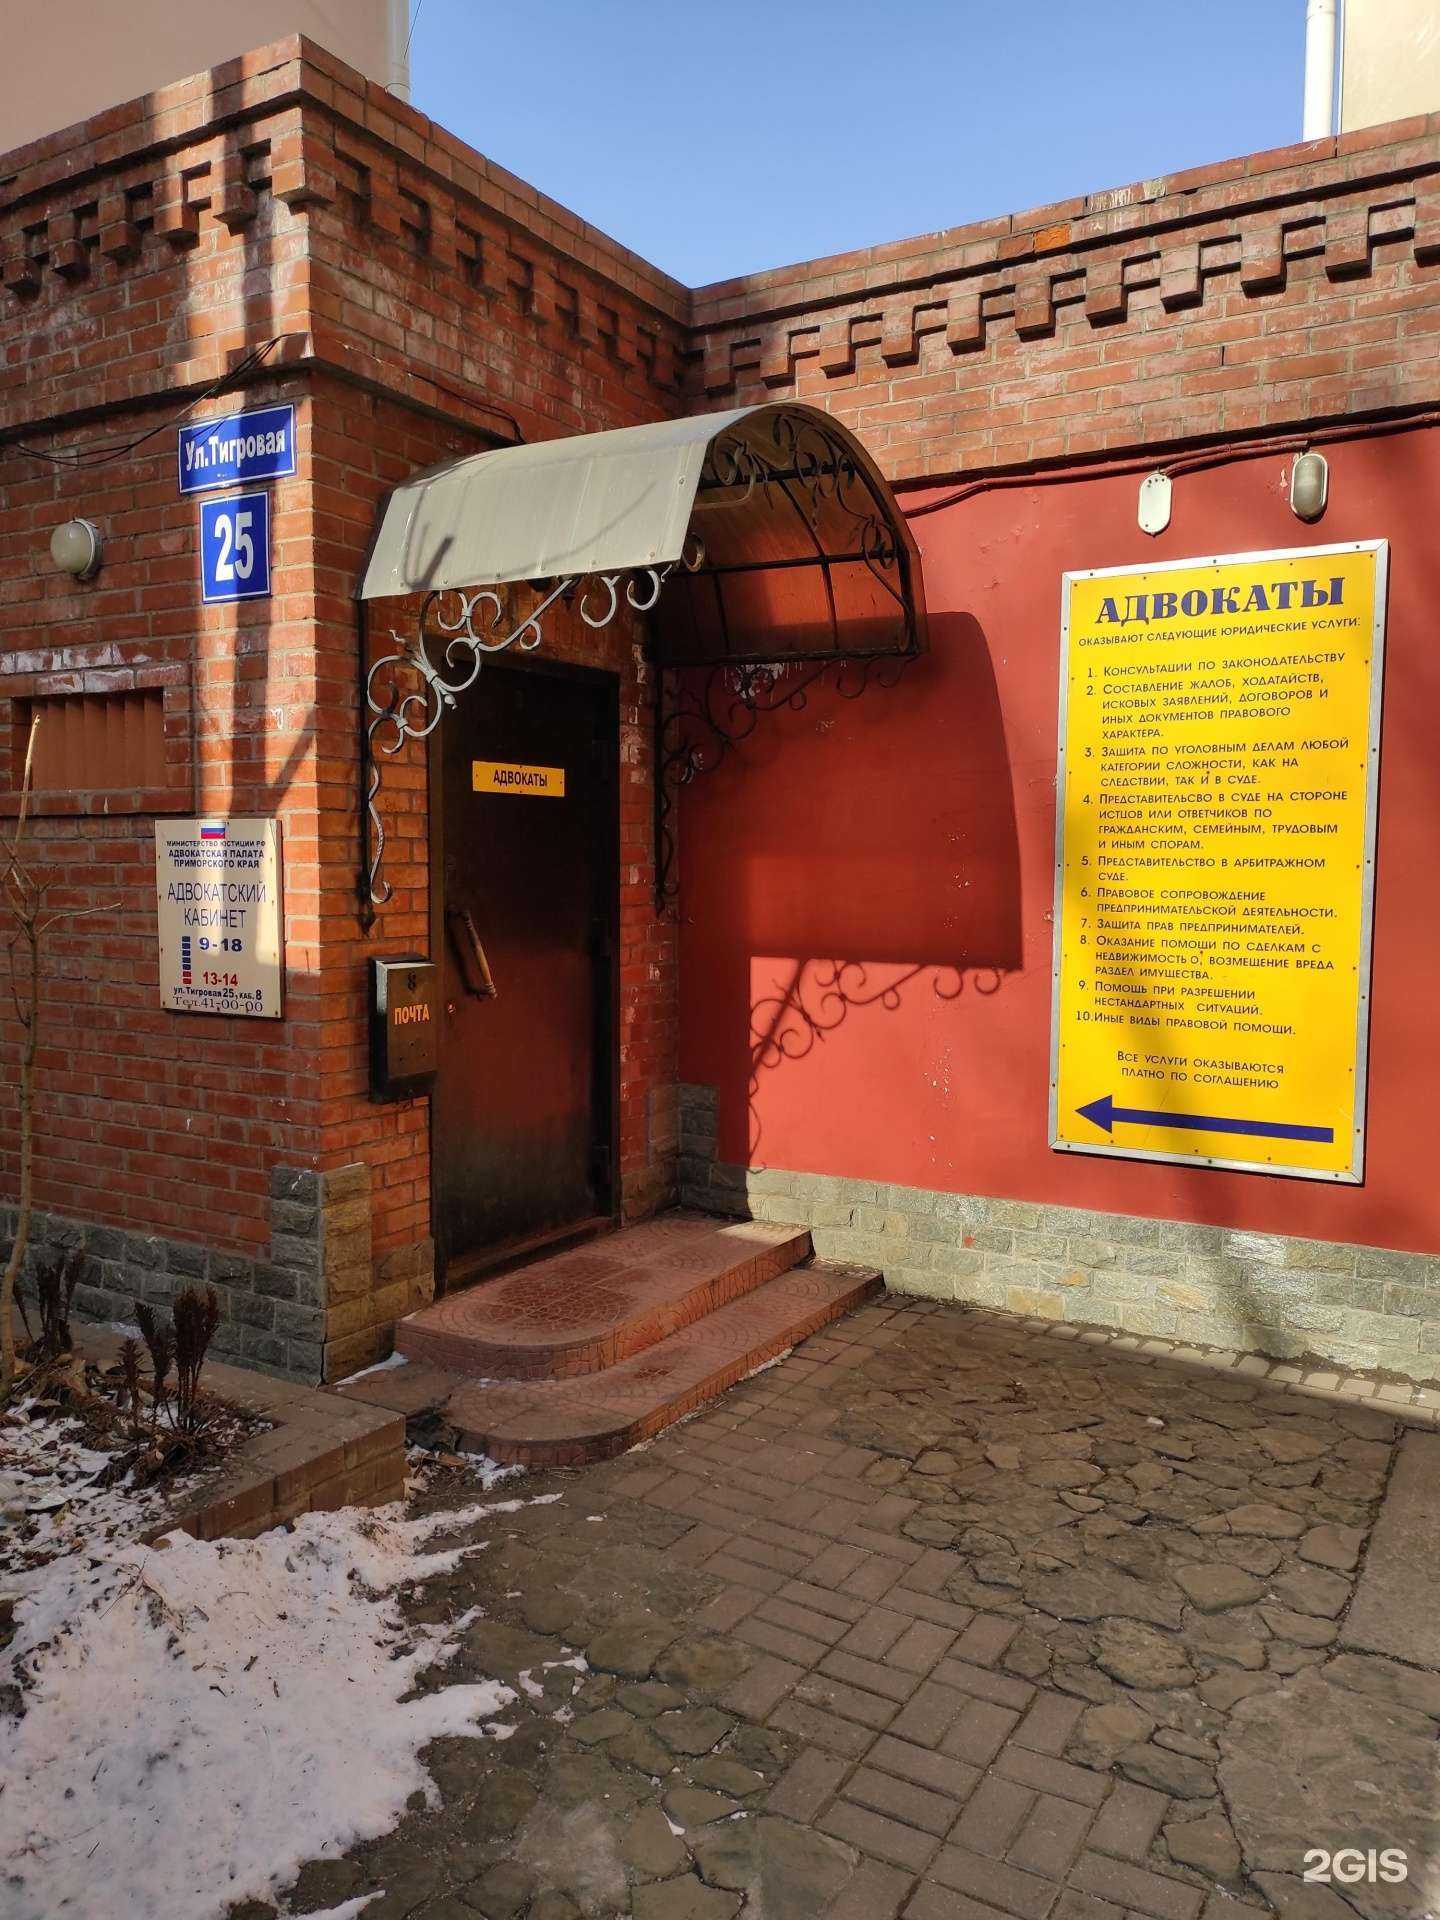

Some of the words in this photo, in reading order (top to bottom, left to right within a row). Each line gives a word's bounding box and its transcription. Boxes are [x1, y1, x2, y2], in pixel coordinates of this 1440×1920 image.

[186, 429, 285, 472] Ул.Тигровая
[214, 512, 253, 581] 25
[1095, 577, 1345, 626] АДВОКАТЫ
[1079, 634, 1144, 647] ОКАЗЫВАЮТ
[1147, 628, 1217, 642] СЛЕДУЮЩИЕ
[1221, 622, 1307, 636] ЮРИДИЧЕСКИЕ
[1312, 617, 1361, 629] УСЛУГИ:
[1198, 661, 1216, 670] ПО
[1222, 653, 1345, 669] ЗАКОНОДАТЕЛЬСТВУ
[1190, 679, 1235, 690] ЖАЛОБ,
[1243, 673, 1324, 686] ХОДАТАЙСТВ,
[1102, 697, 1156, 709] ИСКОВЫХ
[1163, 694, 1232, 706] ЗАЯВЛЕНИЙ,
[1239, 690, 1313, 703] ДОГОВОРОВ
[1320, 689, 1328, 699] И
[1102, 714, 1133, 724] ИНЫХ
[1139, 710, 1214, 723] ДОКУМЕНТОВ
[1220, 706, 1291, 719] ПРАВОВОГО
[1102, 729, 1163, 739] ХАРАКТЕРА.
[1152, 746, 1168, 755] ПО
[1175, 742, 1246, 754] УГОЛОВНЫМ
[1253, 741, 1295, 752] ДЕЛАМ
[1300, 737, 1349, 751] ЛЮБОЙ
[1101, 760, 1160, 772] КАТЕГОРИИ
[1166, 758, 1246, 770] СЛОЖНОСТИ,
[1253, 758, 1276, 768] КАК
[1282, 757, 1298, 767] НА
[494, 770, 547, 787] АДВОКАТЫ
[1101, 776, 1168, 787] СЛЕДСТВИИ,
[1176, 775, 1195, 785] ТАК
[1201, 775, 1209, 784] И
[1215, 775, 1222, 784] В
[1228, 774, 1261, 784] СУДЕ.
[1083, 794, 1093, 805] 4.
[1219, 793, 1225, 801] В
[1232, 791, 1261, 802] СУДЕ
[1268, 791, 1284, 801] НА
[1290, 790, 1348, 801] СТОРОНЕ
[1099, 809, 1143, 819] ИСТЦОВ
[1149, 809, 1172, 818] ИЛИ
[1178, 808, 1247, 818] ОТВЕТЧИКОВ
[1255, 808, 1272, 818] ПО
[1099, 824, 1187, 836] ГРАЖДАНСКИМ,
[1194, 821, 1265, 835] СЕМЕЙНЫМ,
[1272, 824, 1338, 834] ТРУДОВЫМ
[1098, 840, 1106, 848] И
[1112, 840, 1145, 849] ИНЫМ
[1151, 840, 1204, 849] СПОРАМ.
[230, 850, 264, 858] ПАЛАТА
[1081, 856, 1092, 866] 5.
[1222, 858, 1228, 867] В
[1234, 858, 1325, 868] АРБИТРАЖНОМ
[237, 860, 259, 868] КРАЯ
[1098, 872, 1129, 881] СУДЕ.
[167, 881, 266, 904] АДВОКАТСКИЙ
[1161, 890, 1265, 901] СОПРОВОЖДЕНИЕ
[184, 908, 246, 928] КАБИНЕТ
[1097, 904, 1236, 916] ПРЕДПРИНИМАТЕЛЬСКОЙ
[1242, 906, 1338, 918] ДЕЯТЕЛЬНОСТИ.
[1080, 918, 1091, 929] 7.
[1147, 921, 1174, 931] ПРАВ
[1180, 922, 1304, 935] ПРЕДПРИНИМАТЕЛЕЙ.
[1161, 940, 1216, 951] ПОМОЩИ
[1223, 941, 1240, 950] ПО
[1247, 941, 1305, 953] СДЕЛКАМ
[1312, 943, 1321, 953] С
[1209, 956, 1290, 969] ВОЗМЕЩЕНИЕ
[1296, 959, 1334, 970] ВРЕДА
[203, 971, 238, 987] 13-14
[1095, 966, 1135, 977] РАЗДЕЛ
[1140, 969, 1213, 980] ИМУЩЕСТВА.
[256, 989, 262, 1000] 8
[1153, 985, 1175, 995] ПРИ
[1181, 987, 1255, 1000] РАЗРЕШЕНИИ
[1095, 997, 1185, 1011] НЕСТАНДАРТНЫХ
[1197, 1001, 1262, 1015] СИТУАЦИЙ.
[394, 1004, 430, 1025] ПОЧТА
[1130, 1016, 1160, 1026] ВИДЫ
[1166, 1017, 1228, 1032] ПРАВОВОЙ
[1233, 1022, 1296, 1035] ПОМОЩИ.
[1145, 1055, 1188, 1067] УСЛУГИ
[1193, 1058, 1284, 1074] ОКАЗЫВАЮТСЯ
[1122, 1067, 1166, 1080] ПЛАТНО
[1171, 1071, 1188, 1081] ПО
[1193, 1073, 1279, 1089] СОГЛАШЕНИЮ
